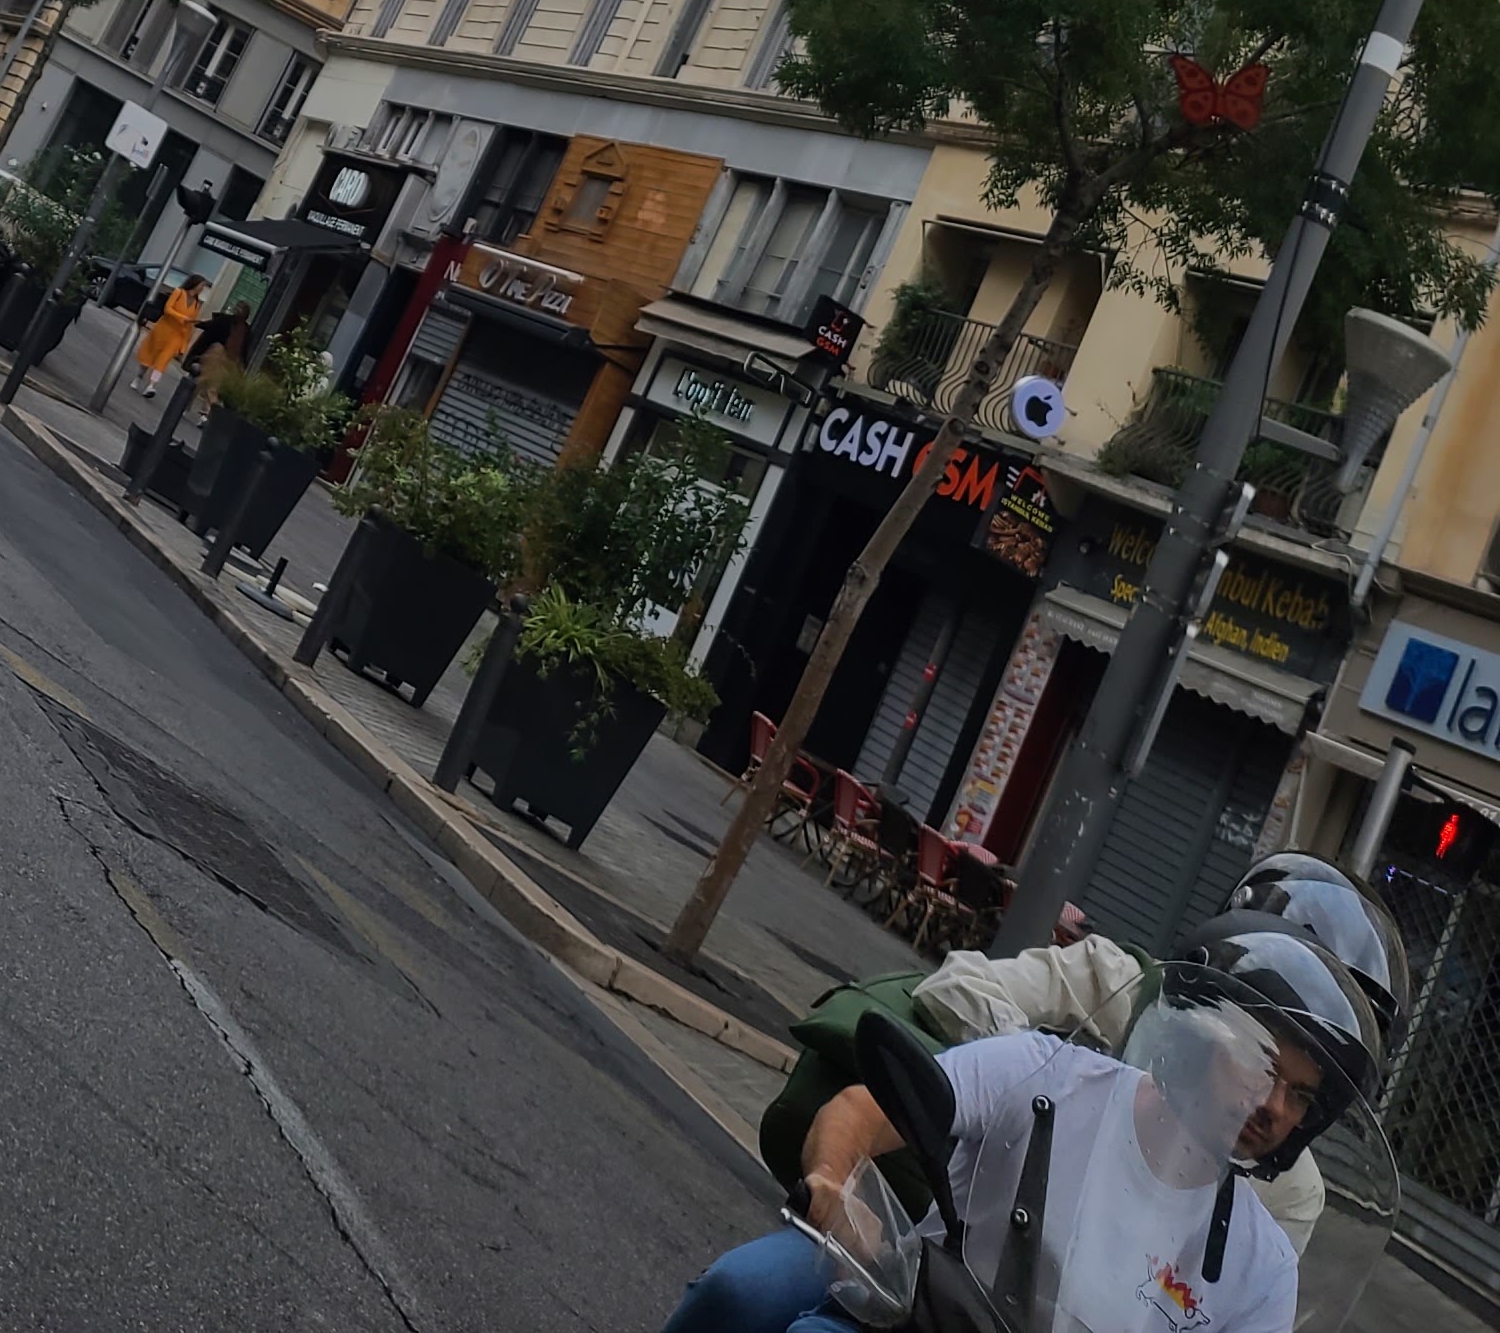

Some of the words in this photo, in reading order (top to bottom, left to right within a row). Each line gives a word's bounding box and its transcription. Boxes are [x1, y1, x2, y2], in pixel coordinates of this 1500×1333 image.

[816, 336, 840, 357] GSM
[818, 325, 847, 349] CASH
[819, 407, 915, 479] CASH
[1010, 493, 1050, 522] WELCOME
[1250, 627, 1290, 662] Indien
